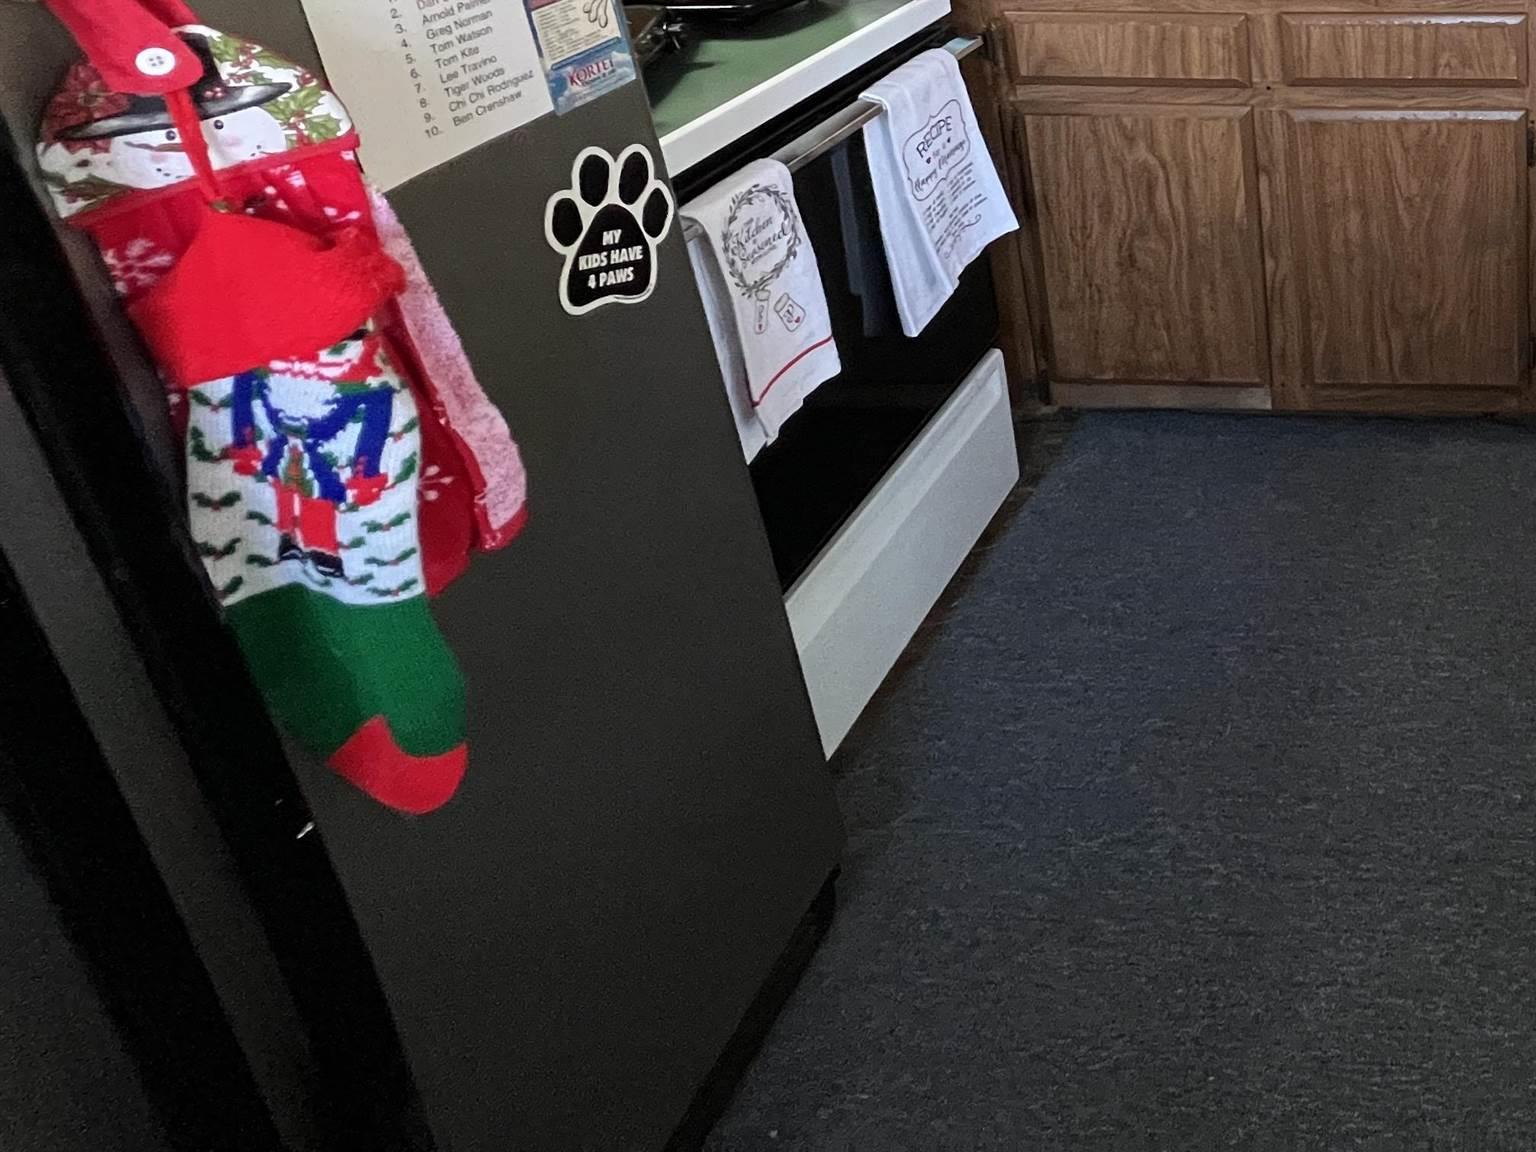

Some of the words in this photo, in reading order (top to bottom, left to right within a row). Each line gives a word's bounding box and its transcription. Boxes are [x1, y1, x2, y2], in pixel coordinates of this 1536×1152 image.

[422, 6, 455, 25] Arnold
[426, 25, 453, 41] Greg
[453, 10, 493, 29] Norman
[430, 40, 455, 55] Tom
[456, 25, 493, 45] Watson
[435, 55, 459, 69] Tom
[460, 46, 480, 60] Kite
[439, 71, 459, 84] Lee
[444, 81, 470, 98] Tiger
[471, 67, 505, 87] Woods
[449, 98, 467, 112] Chi
[468, 89, 485, 104] Chi
[487, 70, 535, 94] Rodriguez
[452, 112, 473, 126] Ben
[475, 90, 522, 116] Crenshaw
[916, 115, 952, 158] RECIPE
[914, 168, 938, 193] Happy
[602, 229, 622, 246] MY
[579, 251, 608, 271] KIDS
[610, 245, 643, 264] HAVE
[588, 274, 596, 289] 4
[599, 266, 634, 287] PAWS
